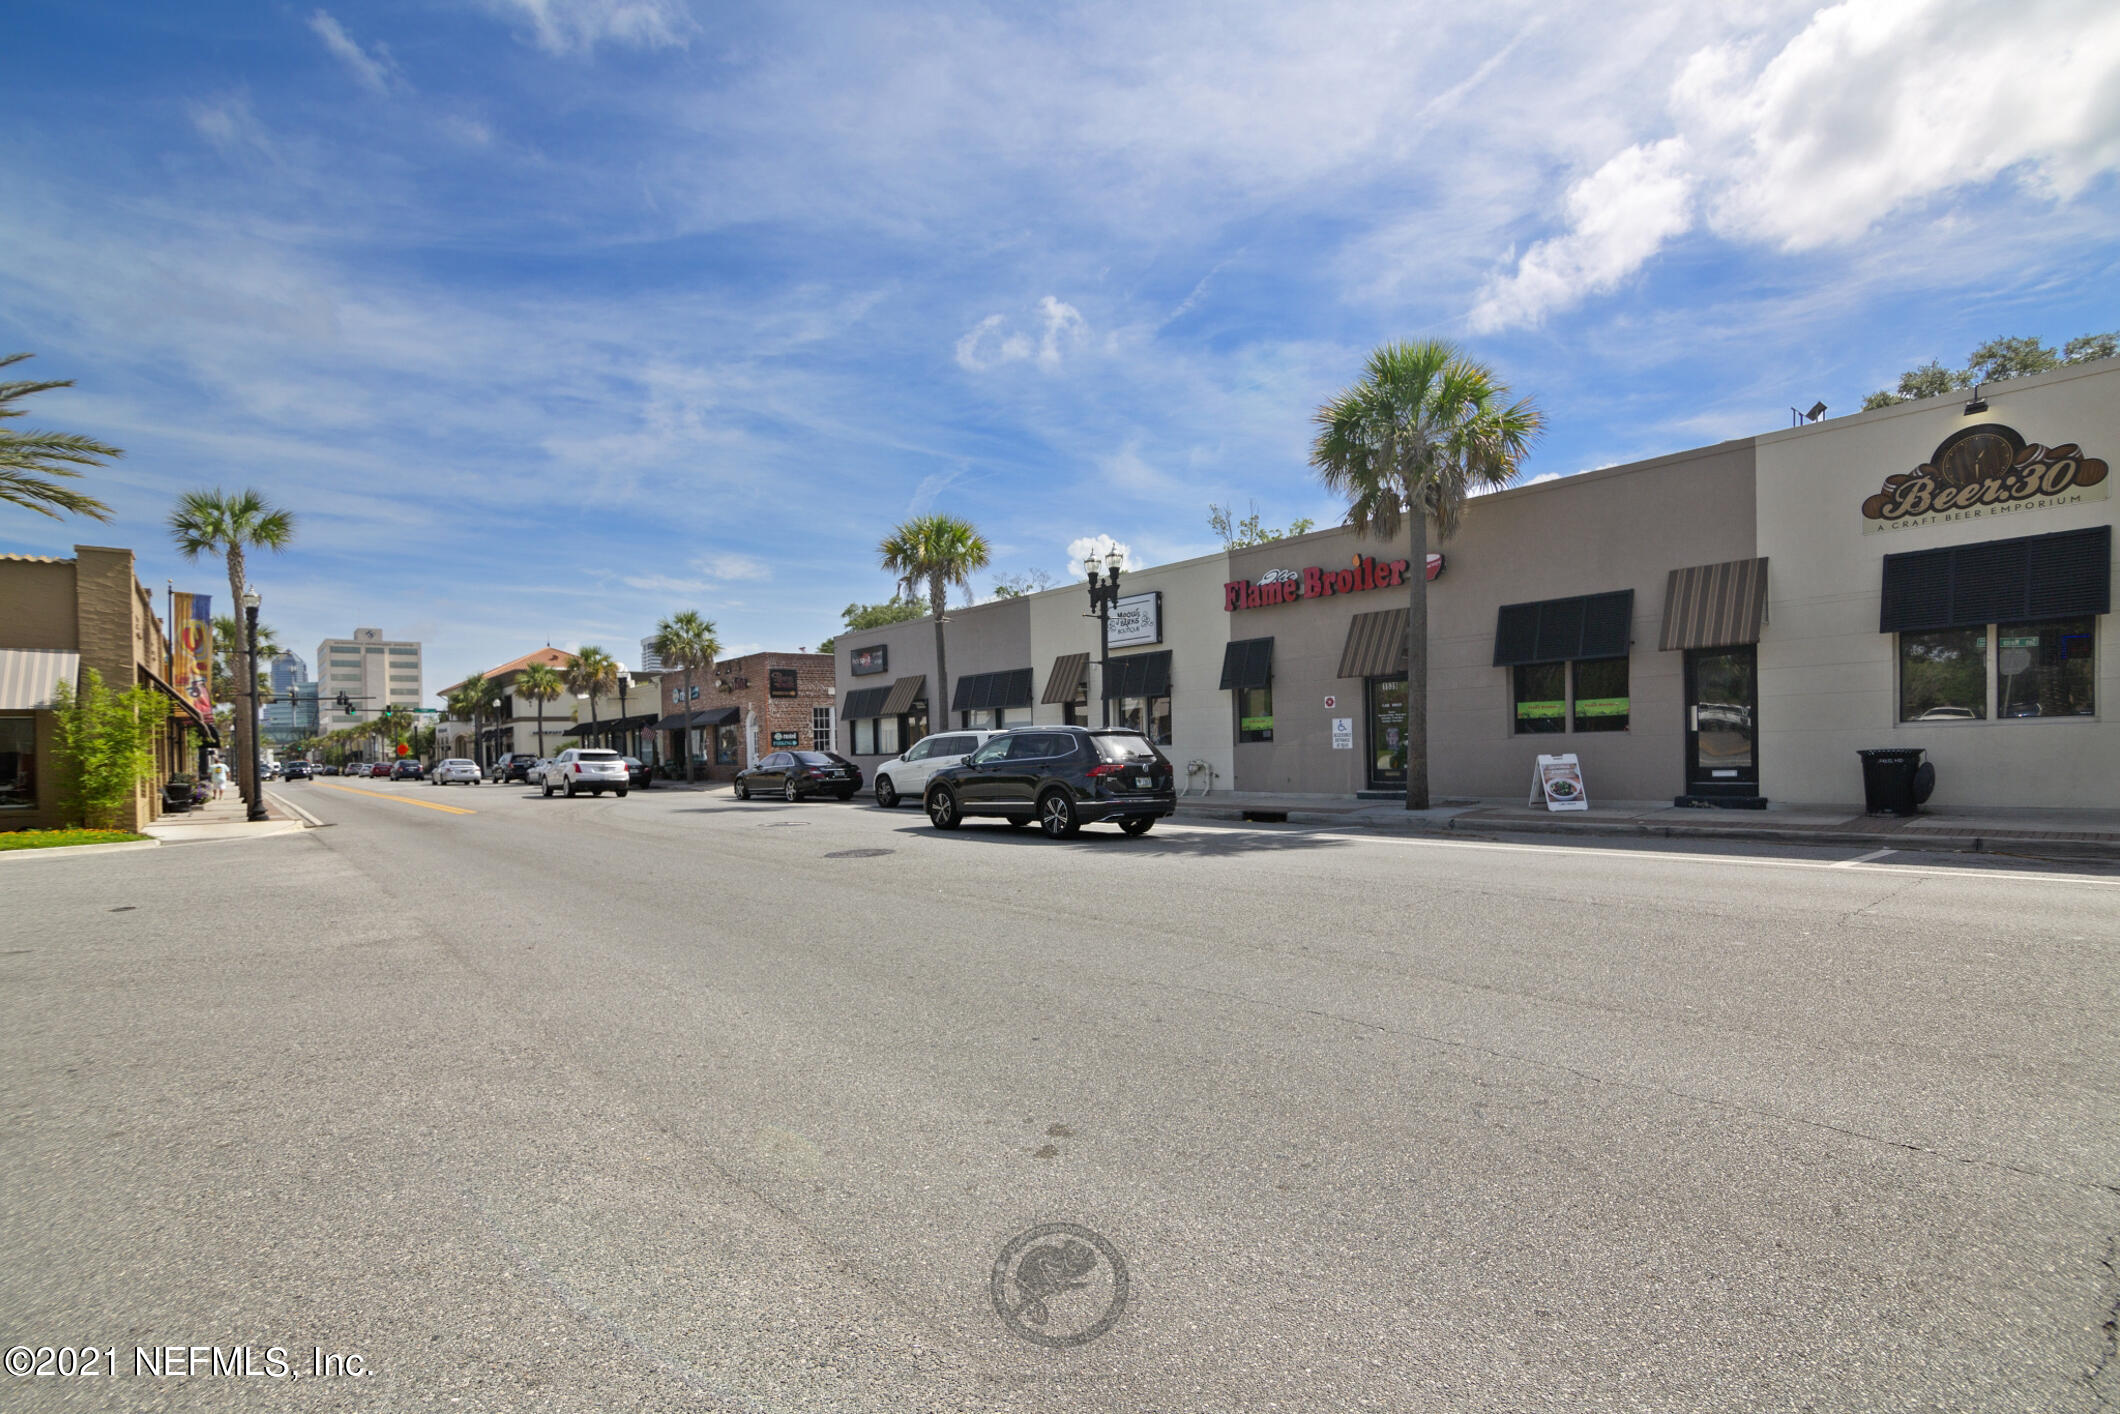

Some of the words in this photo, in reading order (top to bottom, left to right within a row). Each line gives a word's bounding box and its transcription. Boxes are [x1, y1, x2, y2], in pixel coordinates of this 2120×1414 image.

[1882, 460, 2077, 517] Beer:30
[1891, 516, 1937, 529] CRAFT
[1945, 510, 1982, 521] BEER
[1990, 495, 2081, 515] EMPORIUM
[1224, 578, 1298, 612] Flame
[1303, 554, 1409, 599] Broiler
